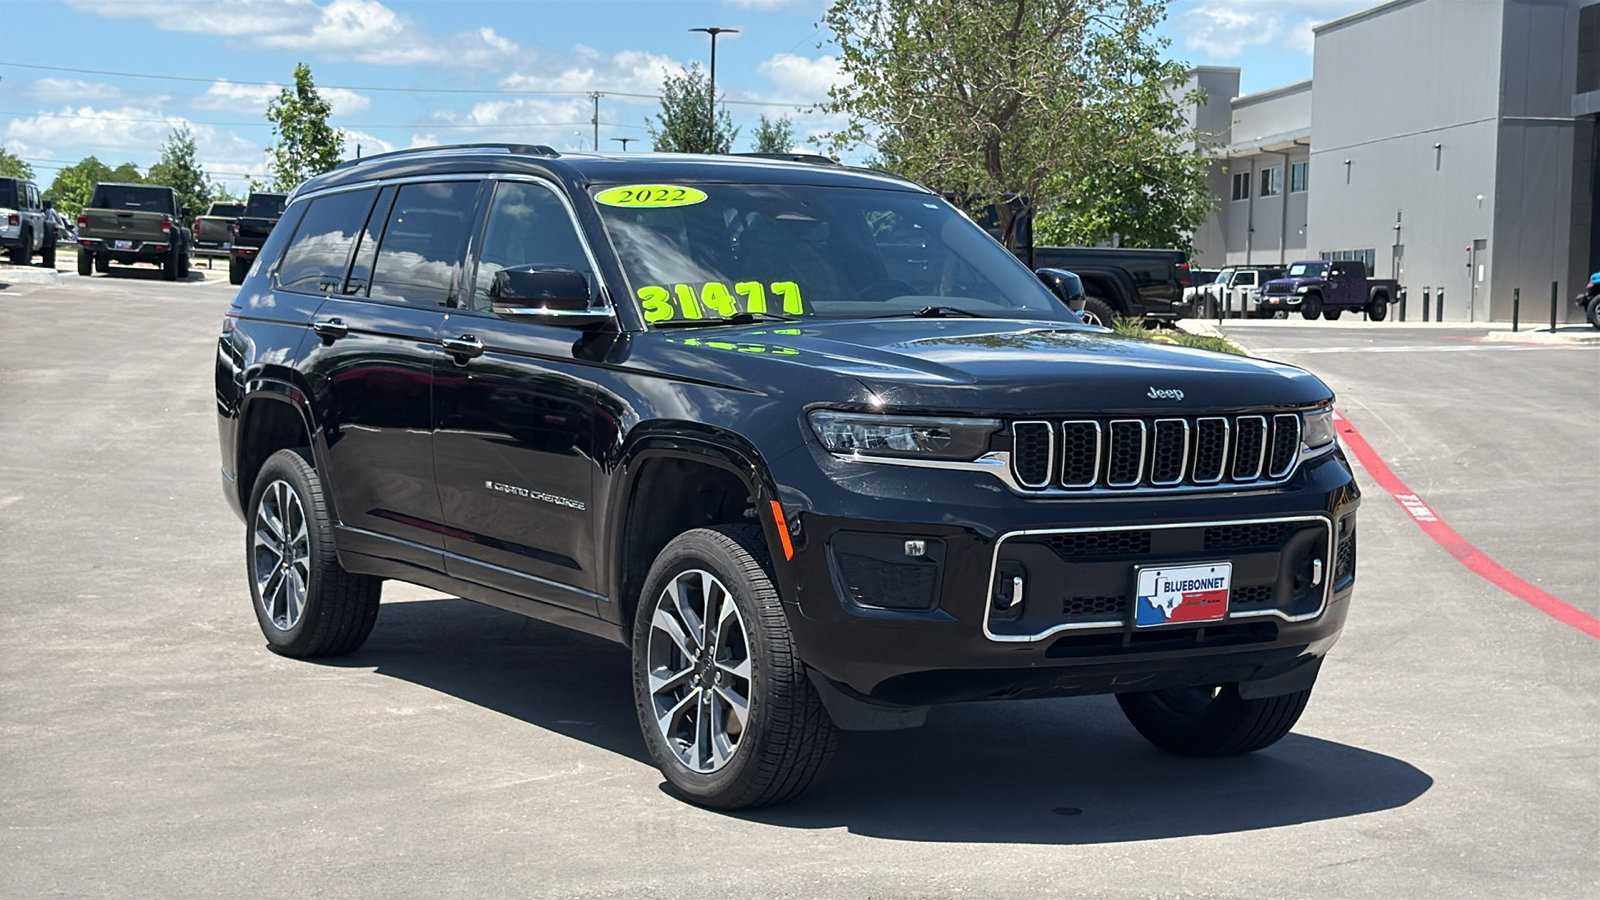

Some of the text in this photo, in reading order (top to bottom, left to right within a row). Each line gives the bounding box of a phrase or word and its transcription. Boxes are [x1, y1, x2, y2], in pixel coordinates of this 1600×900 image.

[618, 189, 686, 203] 2022
[636, 281, 805, 323] 31477
[1147, 386, 1184, 400] Jeep
[494, 483, 586, 510] GRAND CHEROKEE
[1164, 577, 1224, 592] BLUEBONNET
